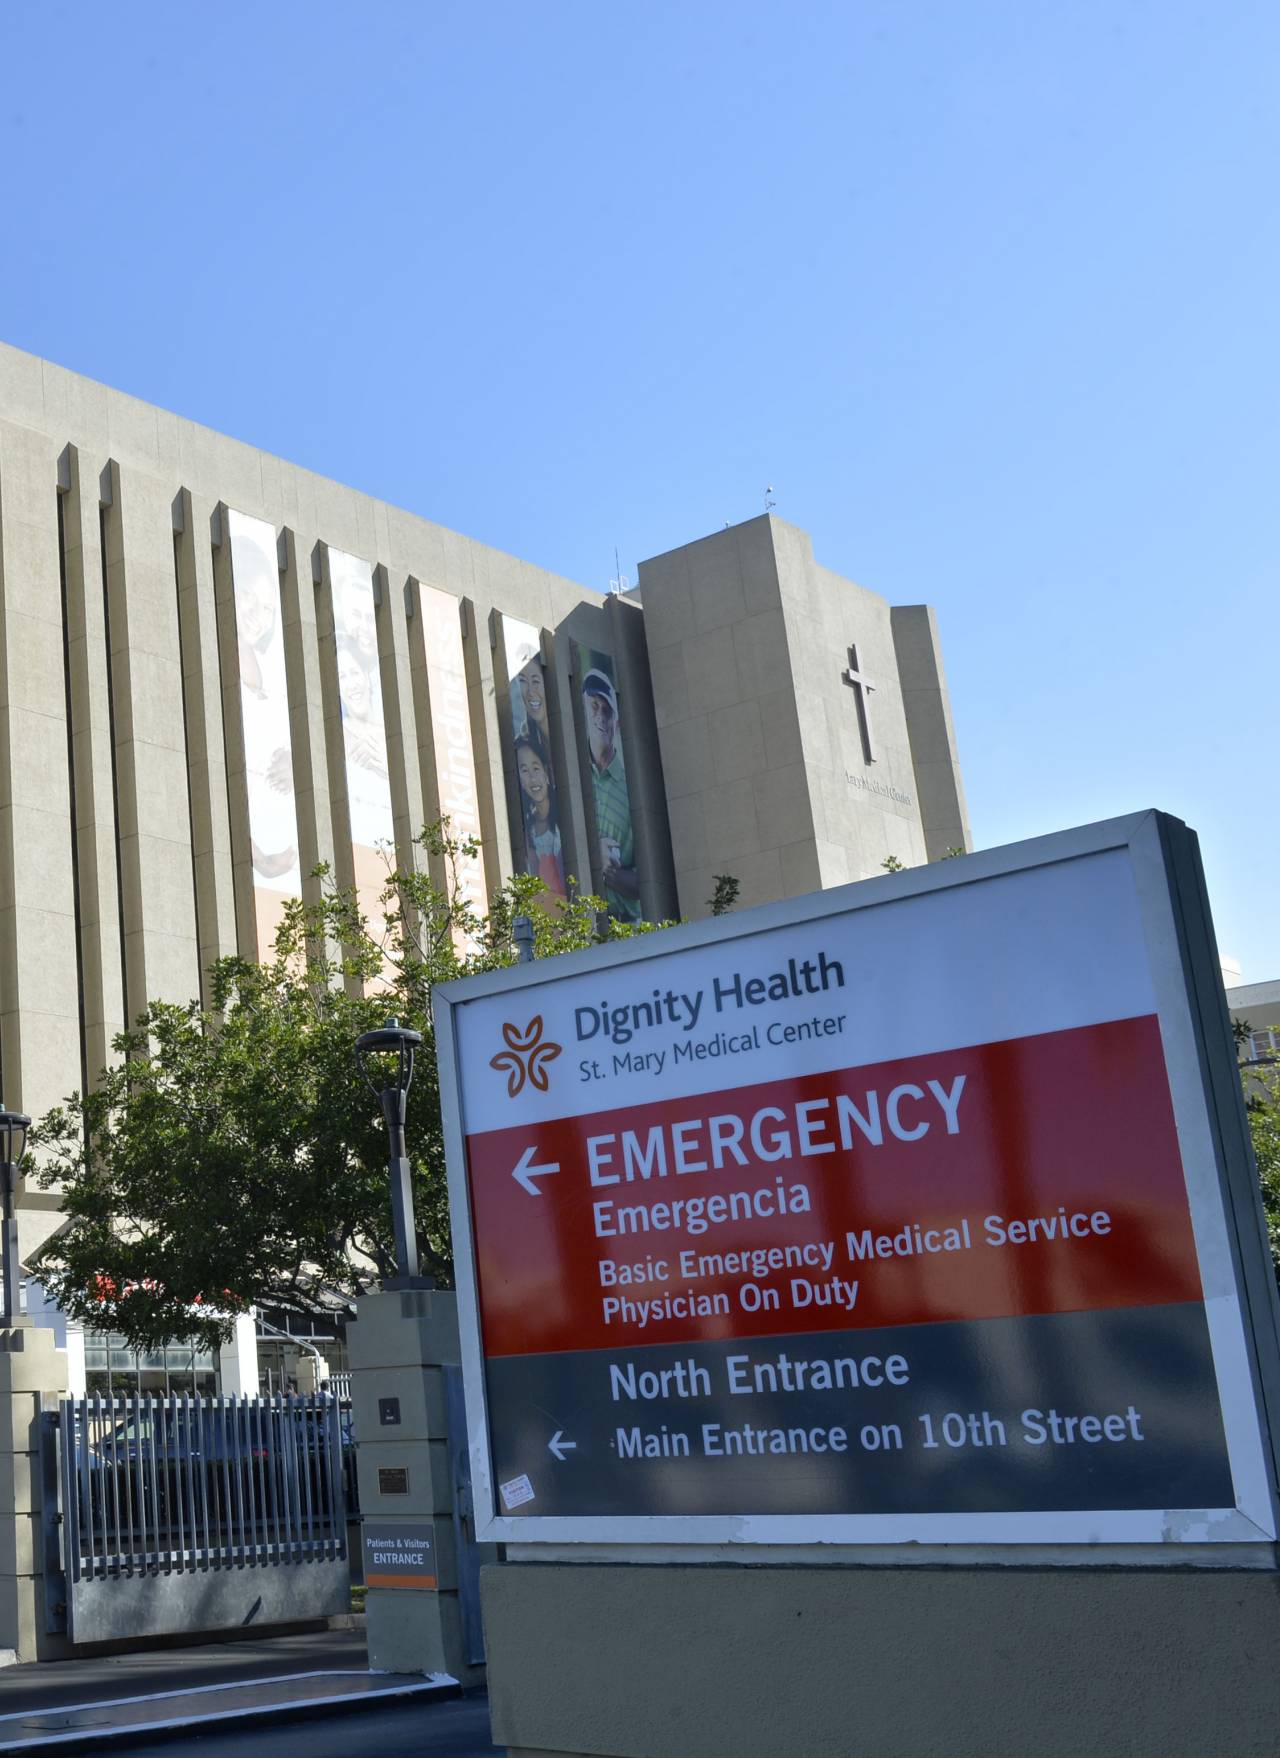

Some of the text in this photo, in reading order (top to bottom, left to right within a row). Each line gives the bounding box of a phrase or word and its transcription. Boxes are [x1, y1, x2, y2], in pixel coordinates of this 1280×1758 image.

[574, 952, 845, 1044] Dignity Health
[579, 1014, 847, 1082] St. Mary Medical Center
[586, 1075, 967, 1187] EMERGENCY
[593, 1176, 811, 1238] Emergencia
[599, 1207, 1111, 1287] Basic Emergency Medical Service
[603, 1276, 858, 1328] Physician On Duty
[609, 1353, 909, 1401] North Entrance
[616, 1406, 1144, 1458] Main Entrance on 10th Street
[367, 1538, 430, 1549] Patients & Visitors
[373, 1552, 424, 1565] ENTRANCE
